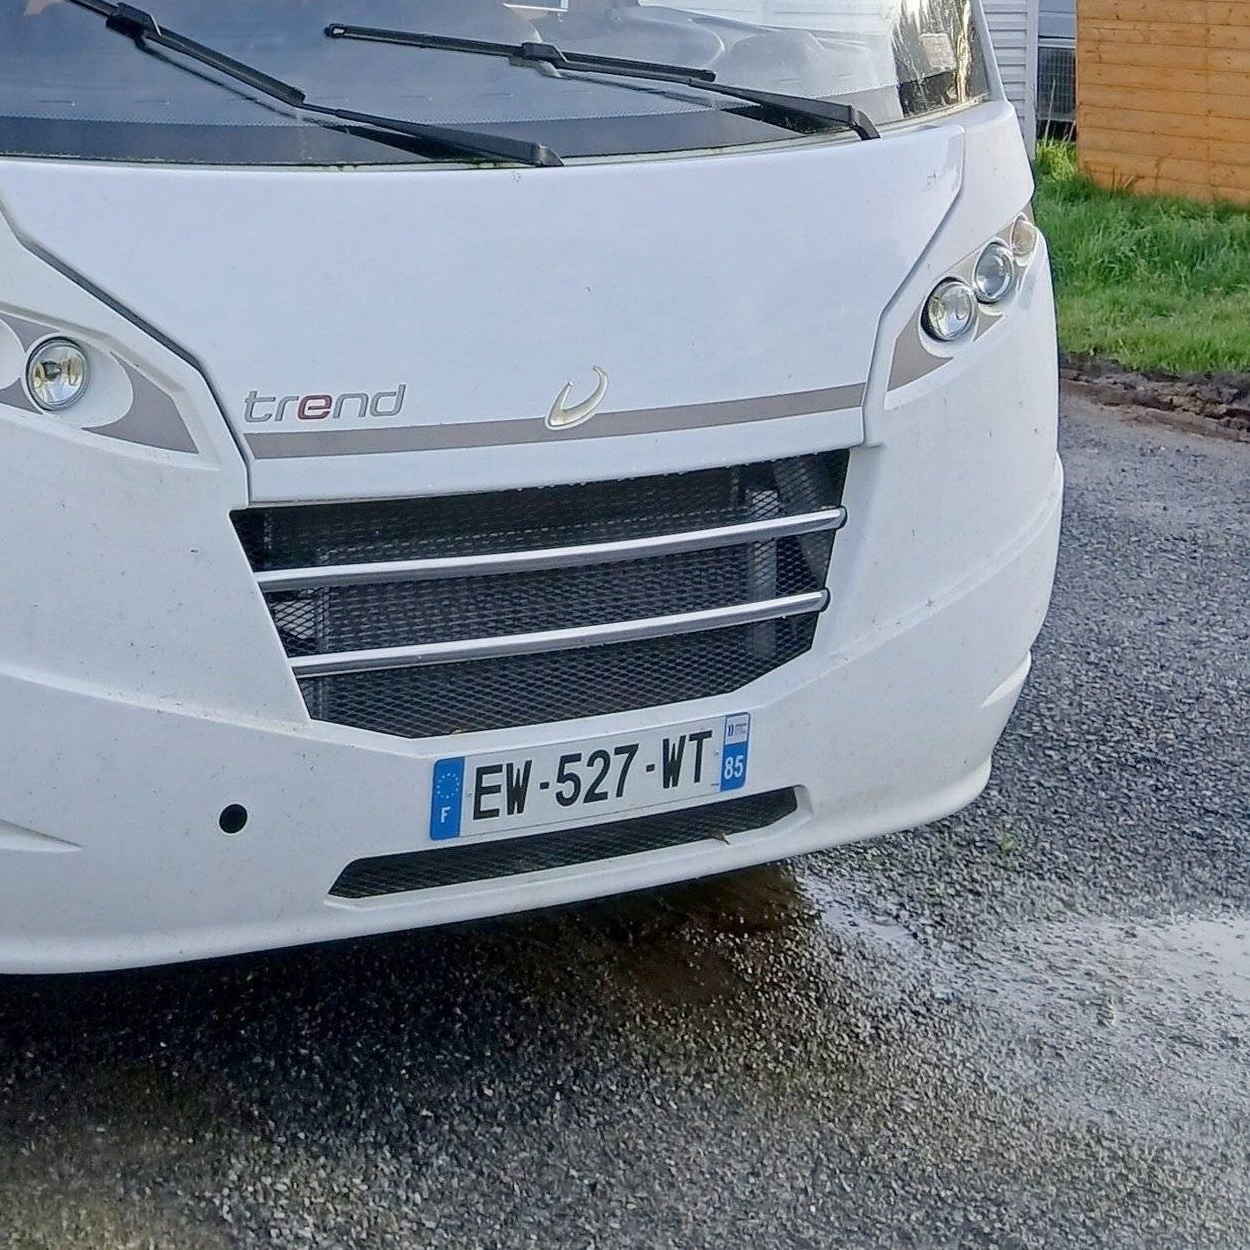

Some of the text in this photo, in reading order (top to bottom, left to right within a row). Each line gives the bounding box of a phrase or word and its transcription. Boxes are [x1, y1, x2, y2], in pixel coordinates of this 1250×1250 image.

[244, 384, 406, 423] trend
[472, 730, 713, 820] EW-527-WT
[724, 754, 744, 780] 85
[440, 806, 451, 823] F
